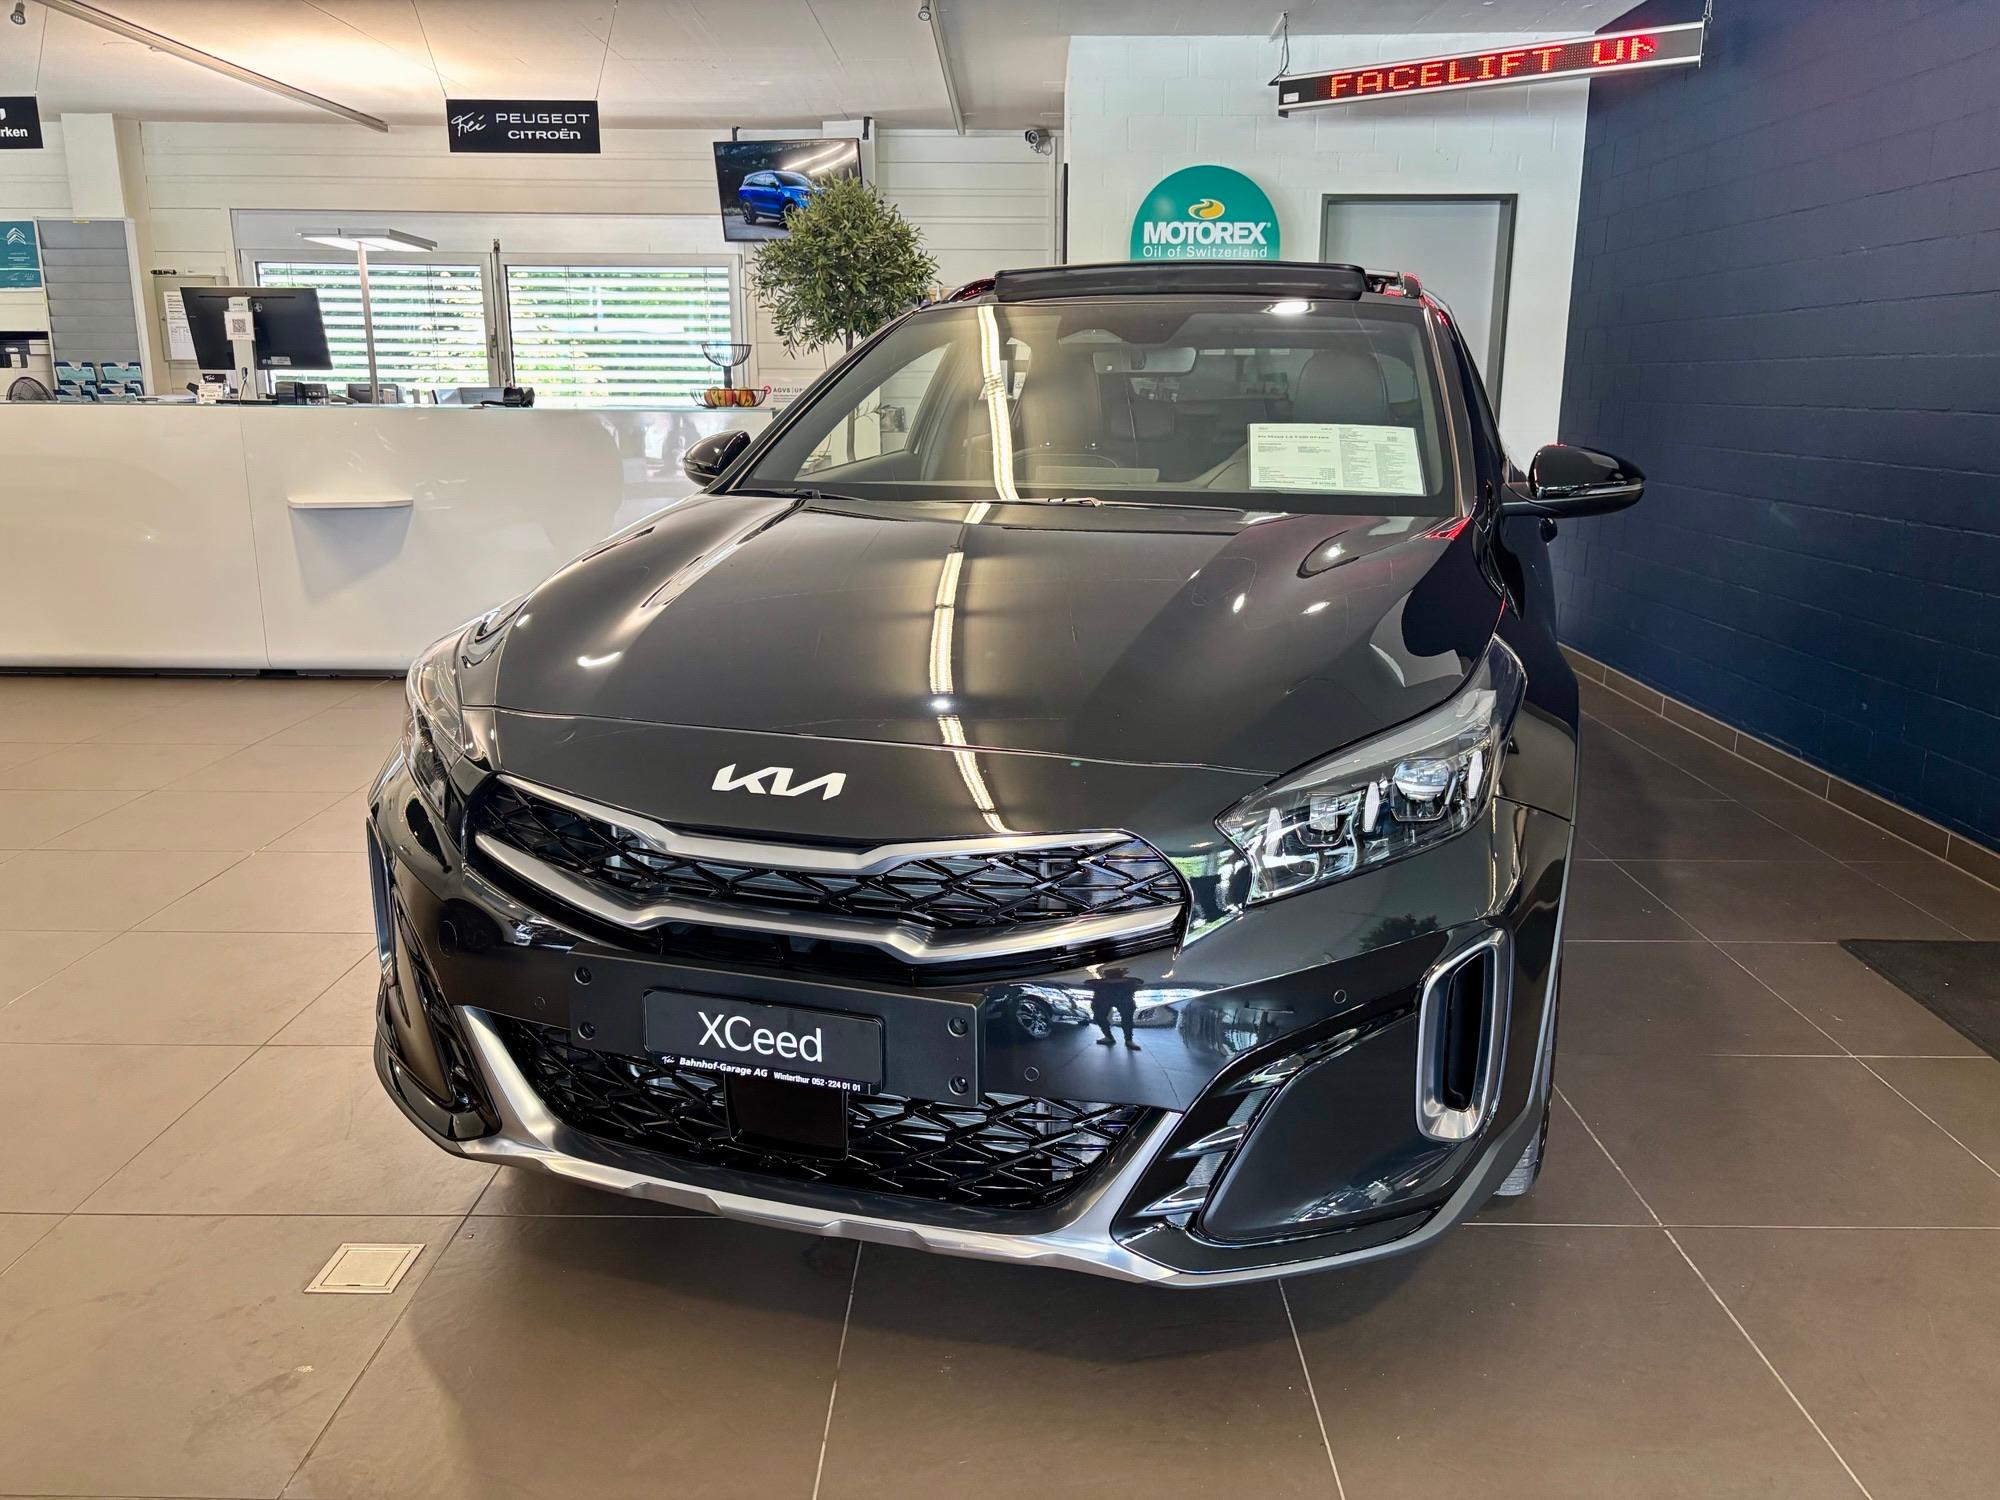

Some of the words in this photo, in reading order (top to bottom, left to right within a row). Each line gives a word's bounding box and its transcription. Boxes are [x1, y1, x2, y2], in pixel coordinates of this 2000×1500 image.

[1330, 46, 1562, 97] FACELIFT
[0, 126, 28, 137] rken
[495, 113, 590, 124] PEUGEOT
[1143, 245, 1161, 257] Oil
[1167, 245, 1181, 257] of
[1186, 245, 1267, 257] Switzerland
[711, 763, 847, 801] KIA
[698, 1011, 823, 1063] XCeed
[679, 1056, 752, 1076] Bahnhof-Garage
[753, 1068, 768, 1077] AG
[774, 1071, 810, 1084] Winterthur
[842, 1082, 851, 1090] 01
[852, 1084, 861, 1092] 01
